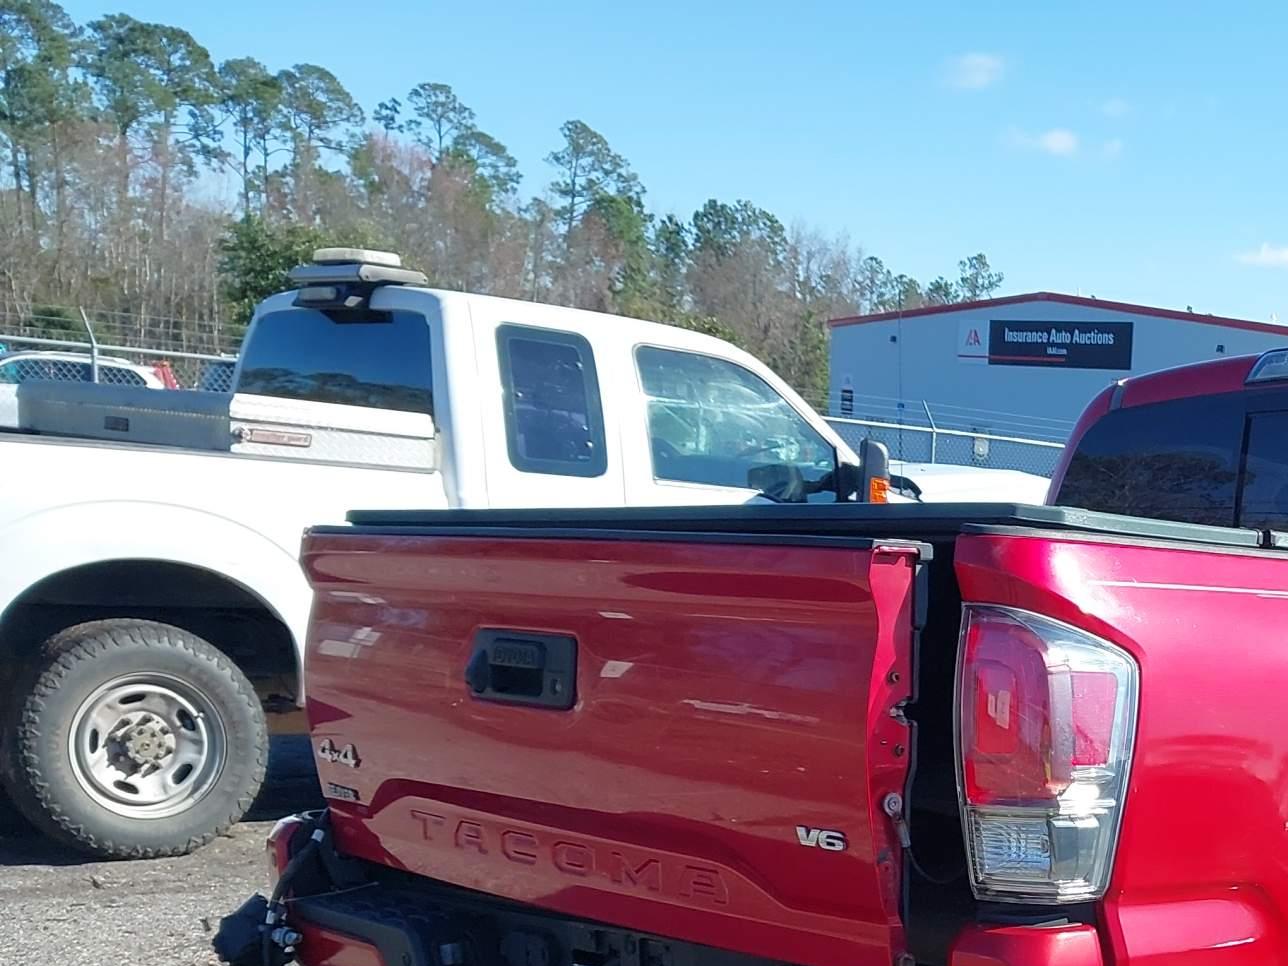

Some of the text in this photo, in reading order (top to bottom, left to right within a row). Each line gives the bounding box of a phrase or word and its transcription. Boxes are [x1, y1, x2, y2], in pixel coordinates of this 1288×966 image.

[1004, 327, 1115, 345] Insurance Auto Auctions
[794, 824, 848, 854] V6
[409, 807, 729, 907] TACOMA
